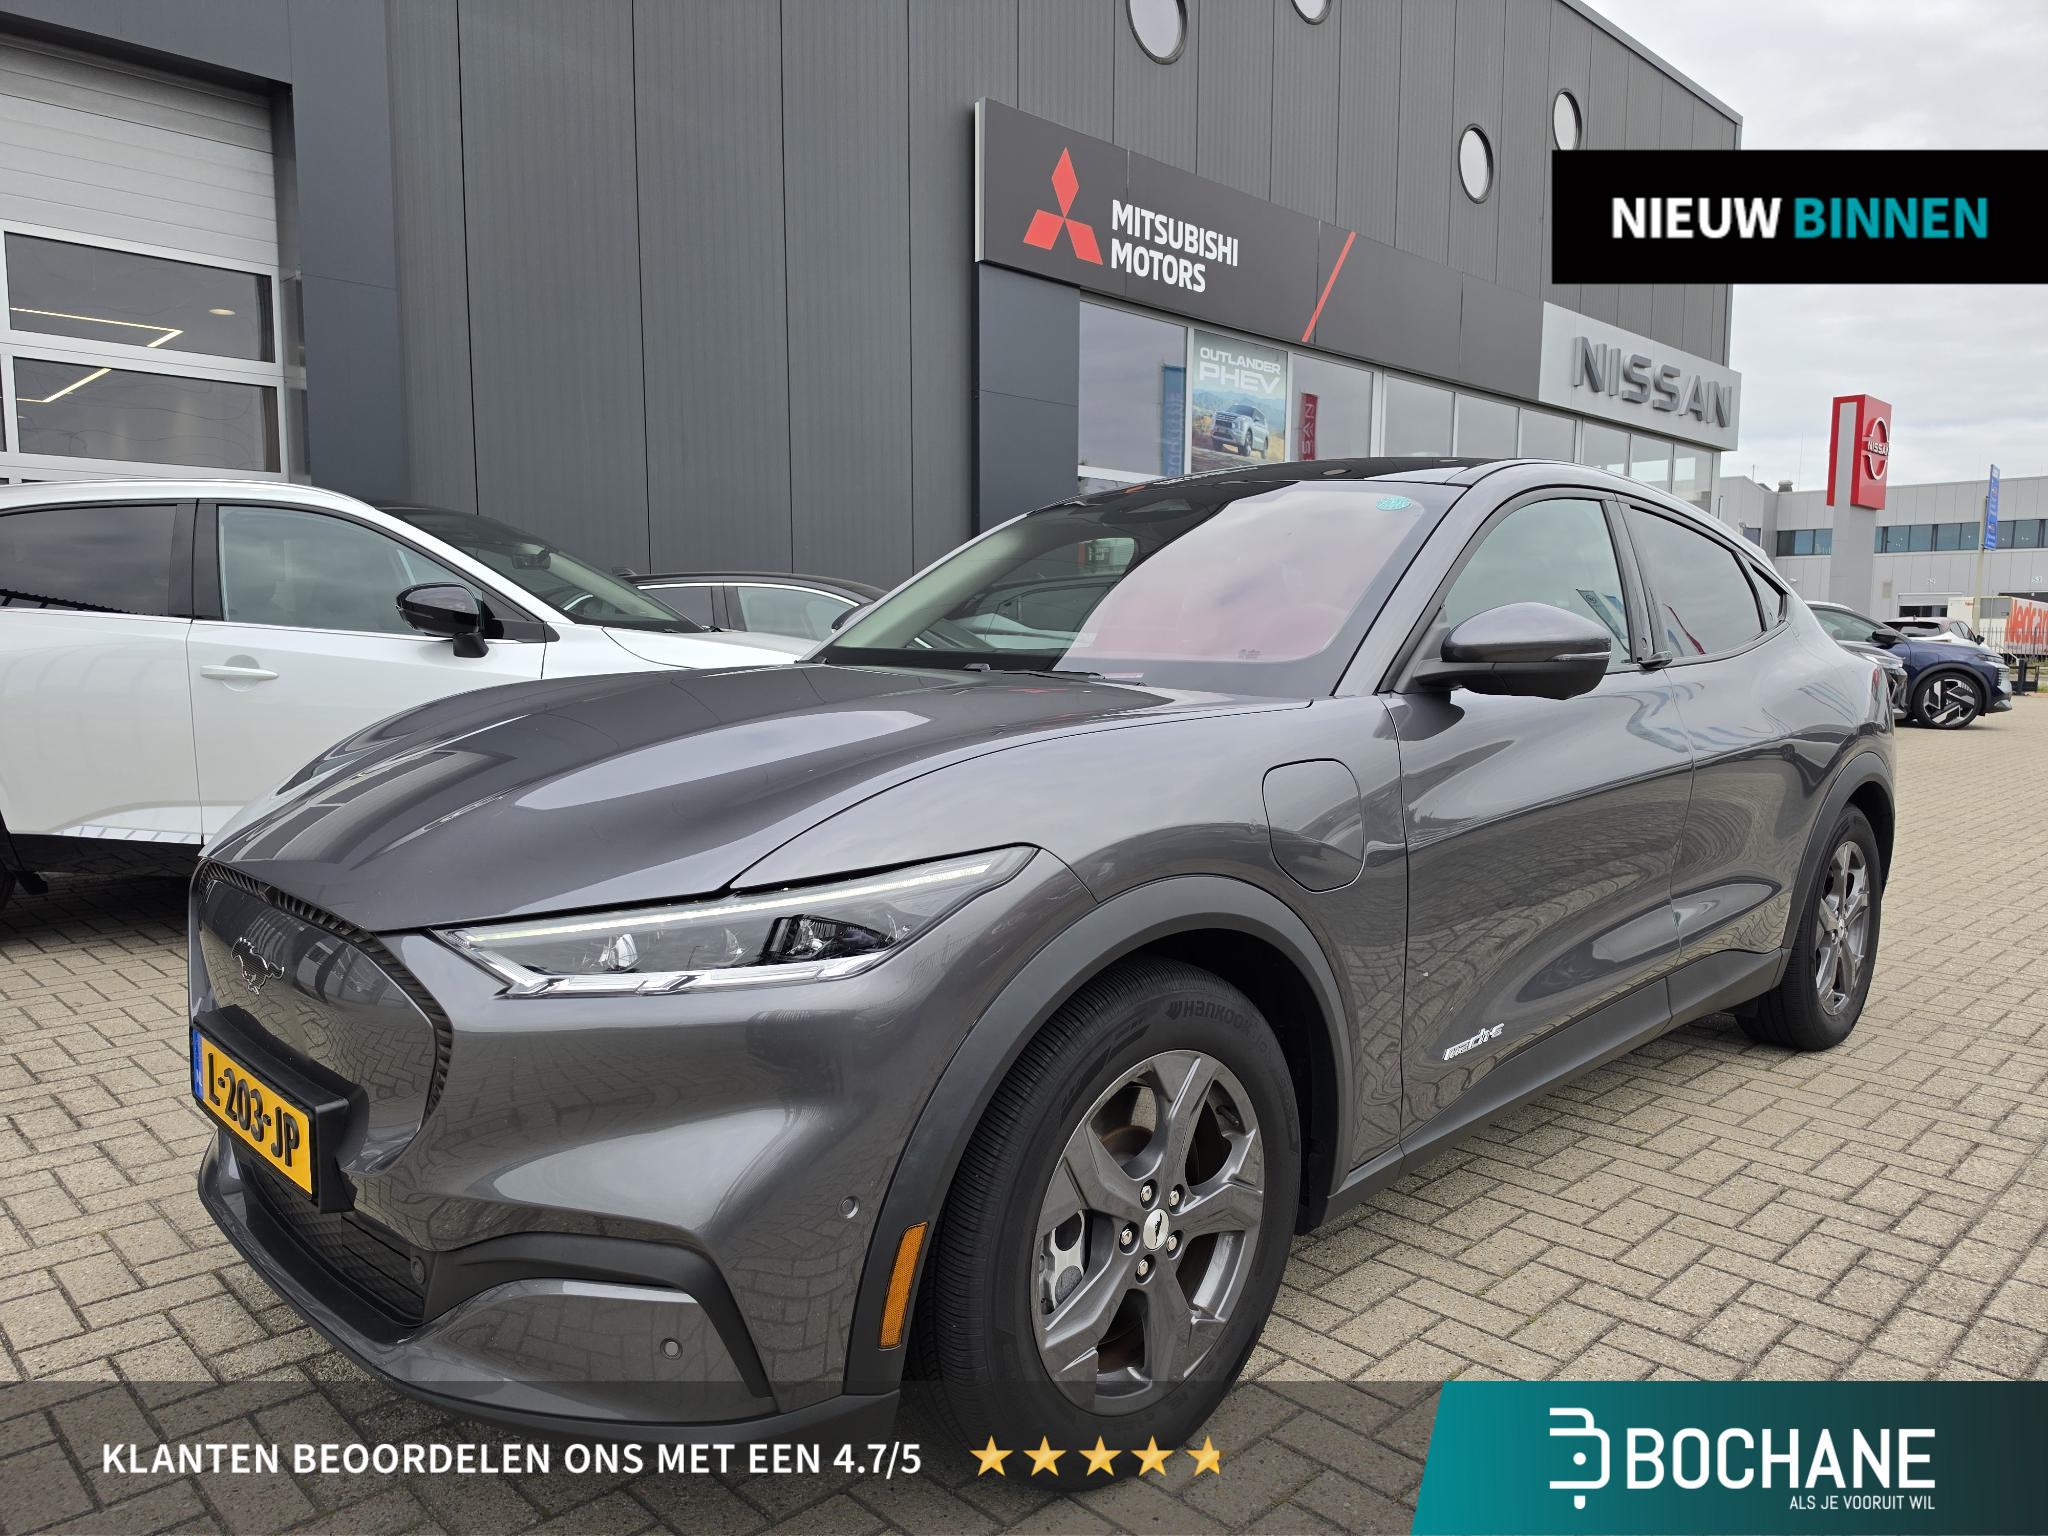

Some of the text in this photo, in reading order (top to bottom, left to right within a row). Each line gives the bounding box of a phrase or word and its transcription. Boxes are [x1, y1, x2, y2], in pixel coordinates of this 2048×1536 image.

[1111, 199, 1239, 267] MITSUBISHI
[1110, 238, 1206, 293] MOTORS
[1199, 361, 1281, 395] PHEV
[1200, 346, 1281, 378] OUTLANDER
[1574, 336, 1733, 428] NISSAN
[207, 1052, 301, 1168] L-203-JP
